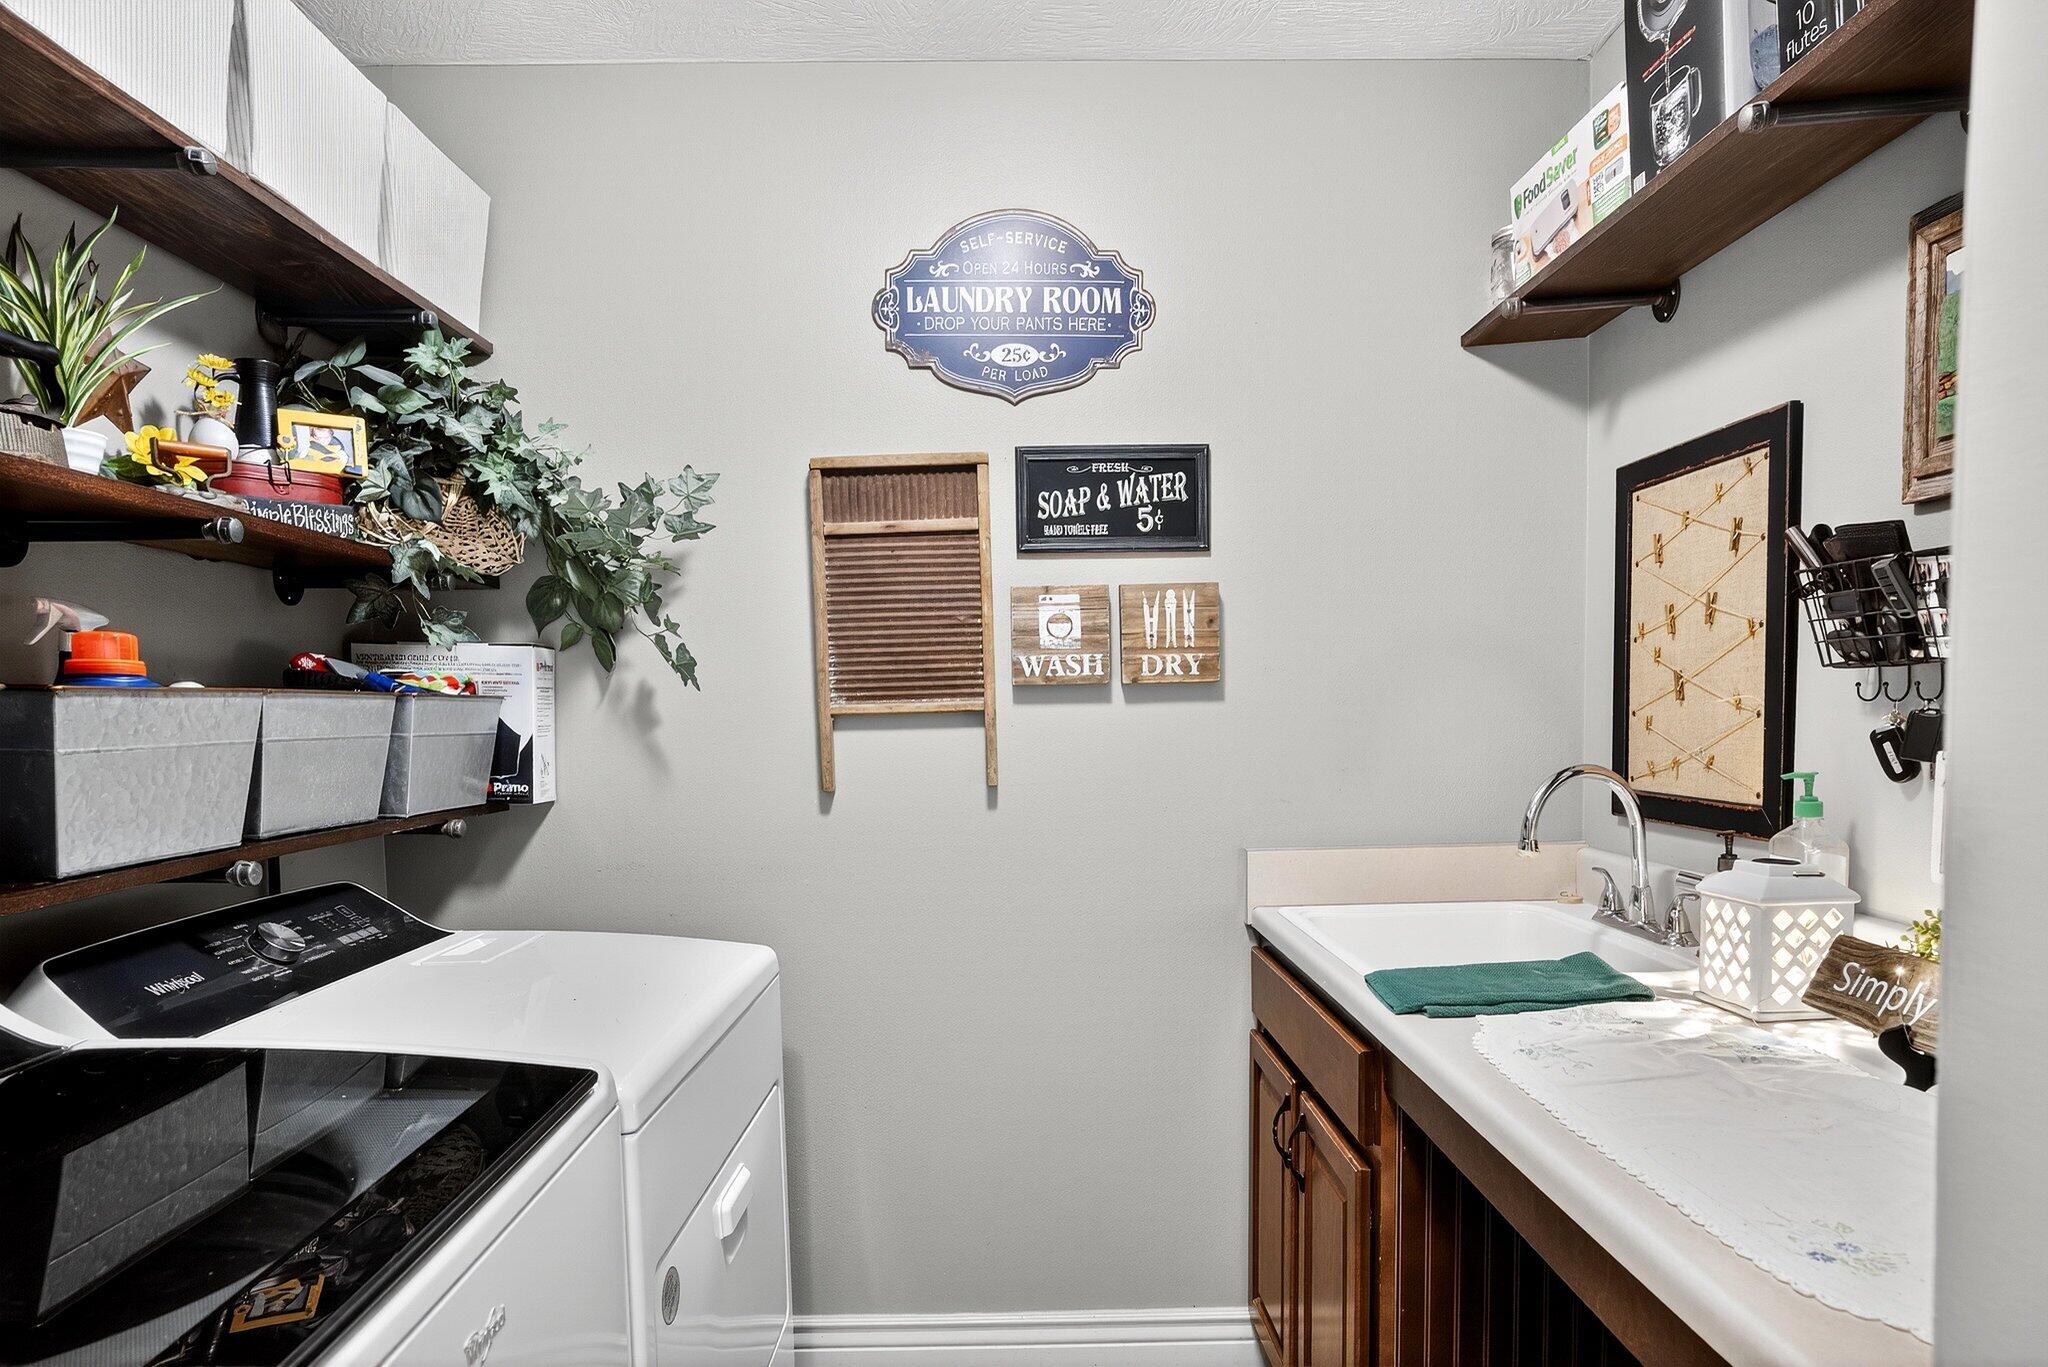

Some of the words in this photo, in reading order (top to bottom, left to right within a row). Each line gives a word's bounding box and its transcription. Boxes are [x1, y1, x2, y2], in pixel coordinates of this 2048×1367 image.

[1795, 0, 1815, 30] 10
[1785, 17, 1828, 62] flutes
[1523, 147, 1578, 209] FoodSaver
[959, 231, 1068, 254] SELF-SERVICE
[1002, 261, 1019, 275] 24
[906, 286, 1033, 314] LAUNDRY
[1043, 286, 1123, 314] ROOM
[924, 317, 965, 331] DROP
[970, 317, 1010, 331] YOUR
[1016, 317, 1063, 331] PANTS
[1068, 317, 1106, 331] HERE
[1001, 347, 1031, 363] 25¢
[981, 366, 1007, 382] PER
[1014, 365, 1049, 382] LOAD
[1091, 462, 1129, 473] FRESH
[1037, 486, 1091, 520] SOAP
[1097, 482, 1111, 511] &
[1117, 471, 1189, 509] WATER
[1136, 505, 1164, 533] 5¢
[1018, 653, 1105, 678] WASH
[1140, 653, 1205, 677] DRY
[493, 779, 529, 792] Primo
[143, 971, 205, 997] Whirlpool
[1833, 961, 1938, 1026] Simply
